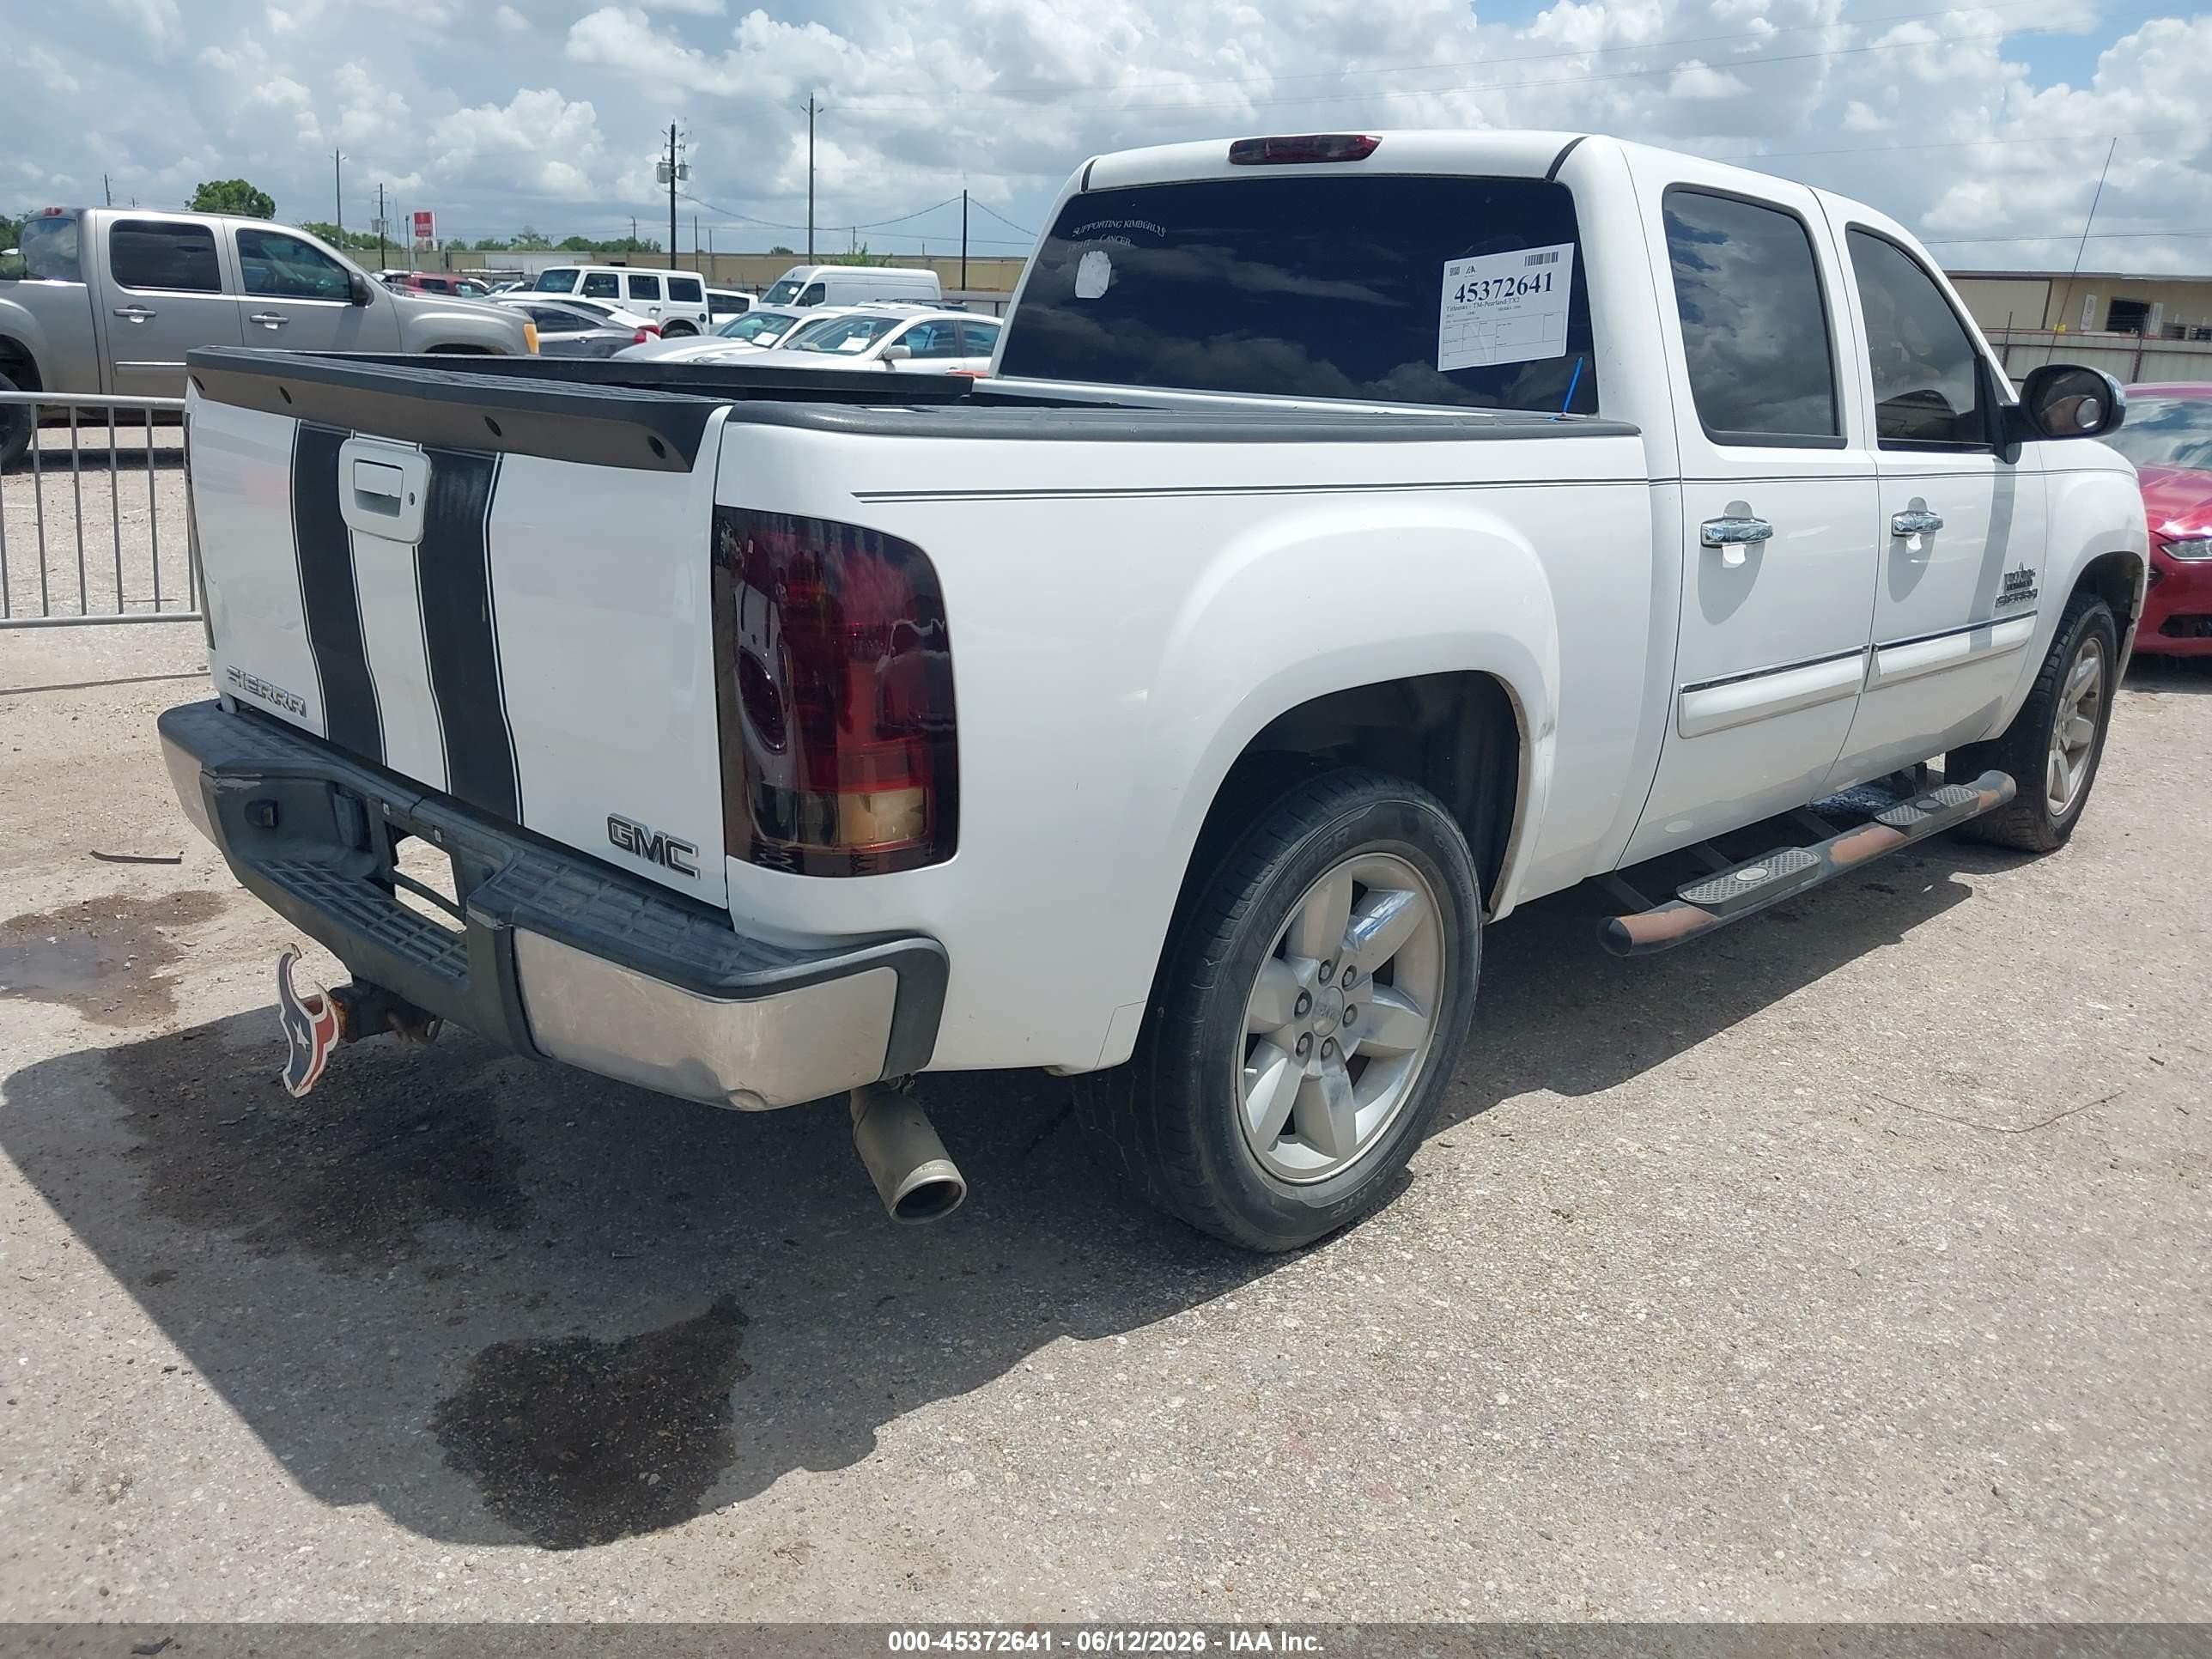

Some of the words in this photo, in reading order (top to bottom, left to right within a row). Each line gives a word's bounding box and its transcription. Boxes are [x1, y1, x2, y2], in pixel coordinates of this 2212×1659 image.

[1454, 271, 1553, 304] 45372641
[226, 664, 307, 719] SIERRA
[606, 811, 701, 880] GMC
